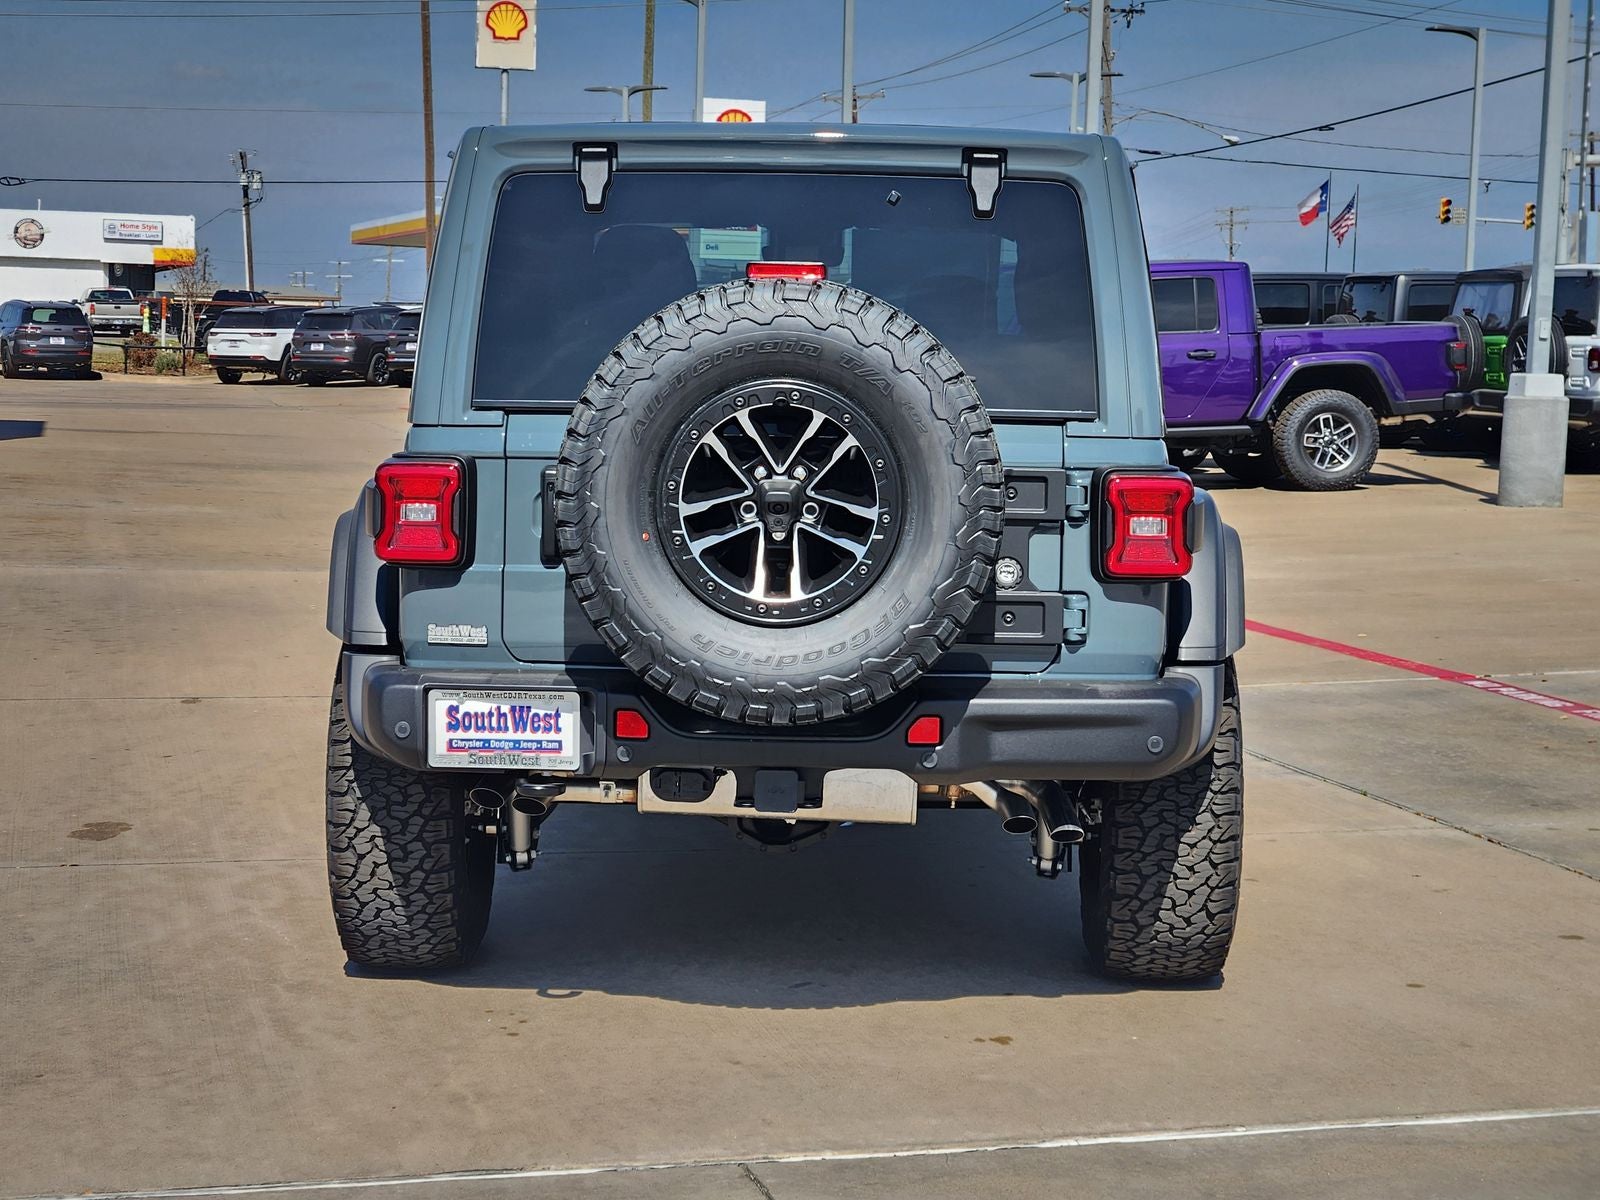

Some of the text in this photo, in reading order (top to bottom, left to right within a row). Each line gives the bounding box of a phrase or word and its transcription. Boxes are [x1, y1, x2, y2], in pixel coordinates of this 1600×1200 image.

[120, 222, 159, 231] Home Style
[705, 243, 719, 251] Deli
[840, 351, 896, 397] T/A
[428, 623, 487, 638] SouthWest
[690, 592, 912, 671] BFGoodrich
[446, 704, 562, 734] SouthWest
[452, 738, 559, 750] Chrysler Dodge Jeep Ram
[468, 753, 542, 767] SouthWest
